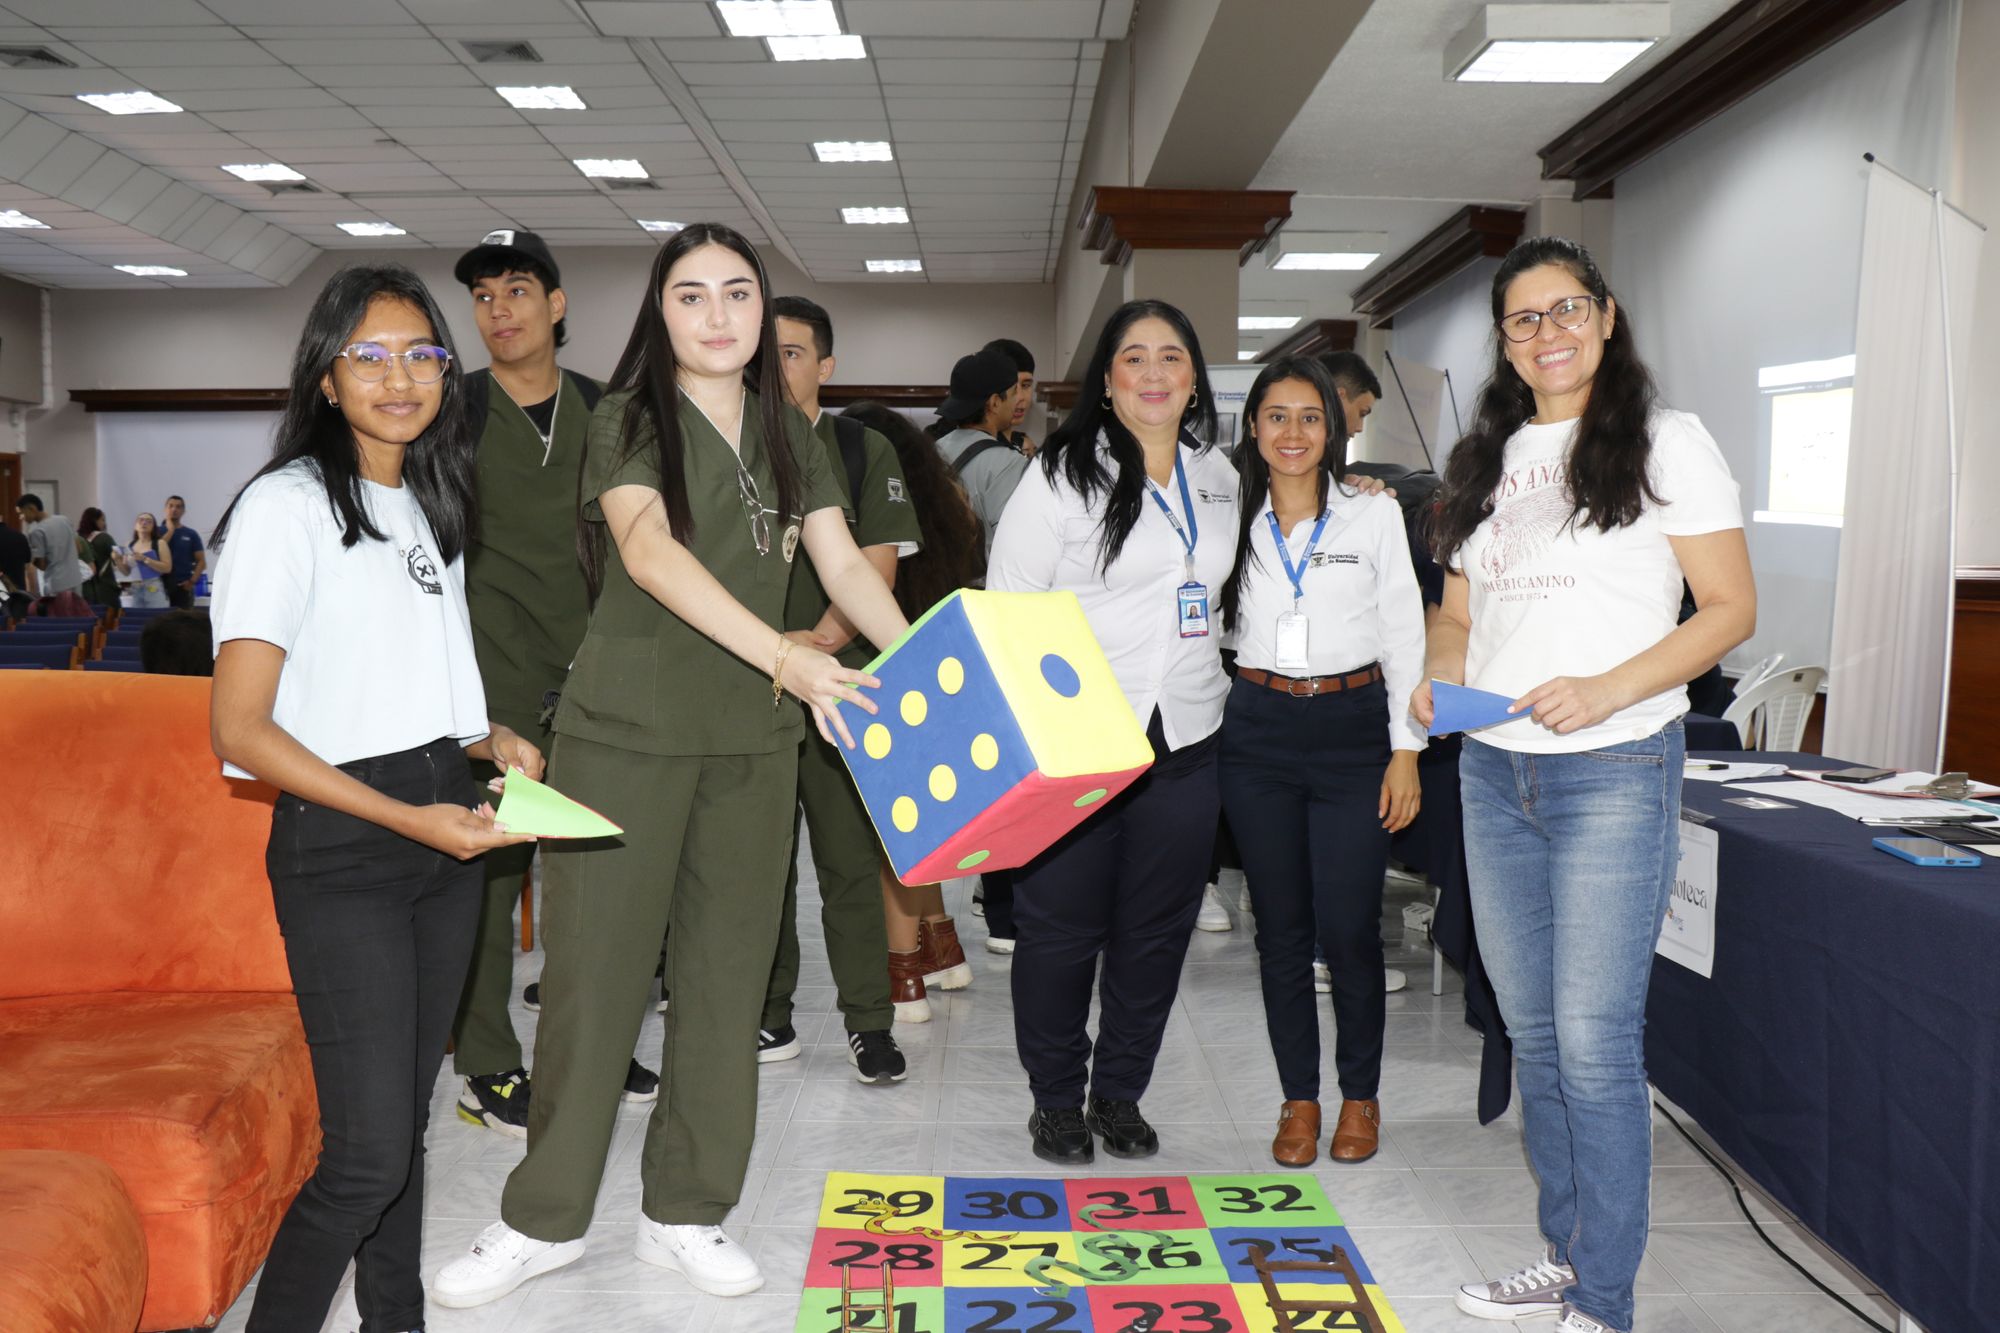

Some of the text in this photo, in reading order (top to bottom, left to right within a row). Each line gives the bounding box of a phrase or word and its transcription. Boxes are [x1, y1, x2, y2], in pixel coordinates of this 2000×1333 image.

[1490, 463, 1566, 503] OS ANG
[834, 1184, 1317, 1219] 29 30 31 32
[828, 1237, 1338, 1271] 28 27 26 25
[826, 1302, 931, 1333] 21
[966, 1300, 1083, 1333] 22
[1113, 1301, 1233, 1333] 23
